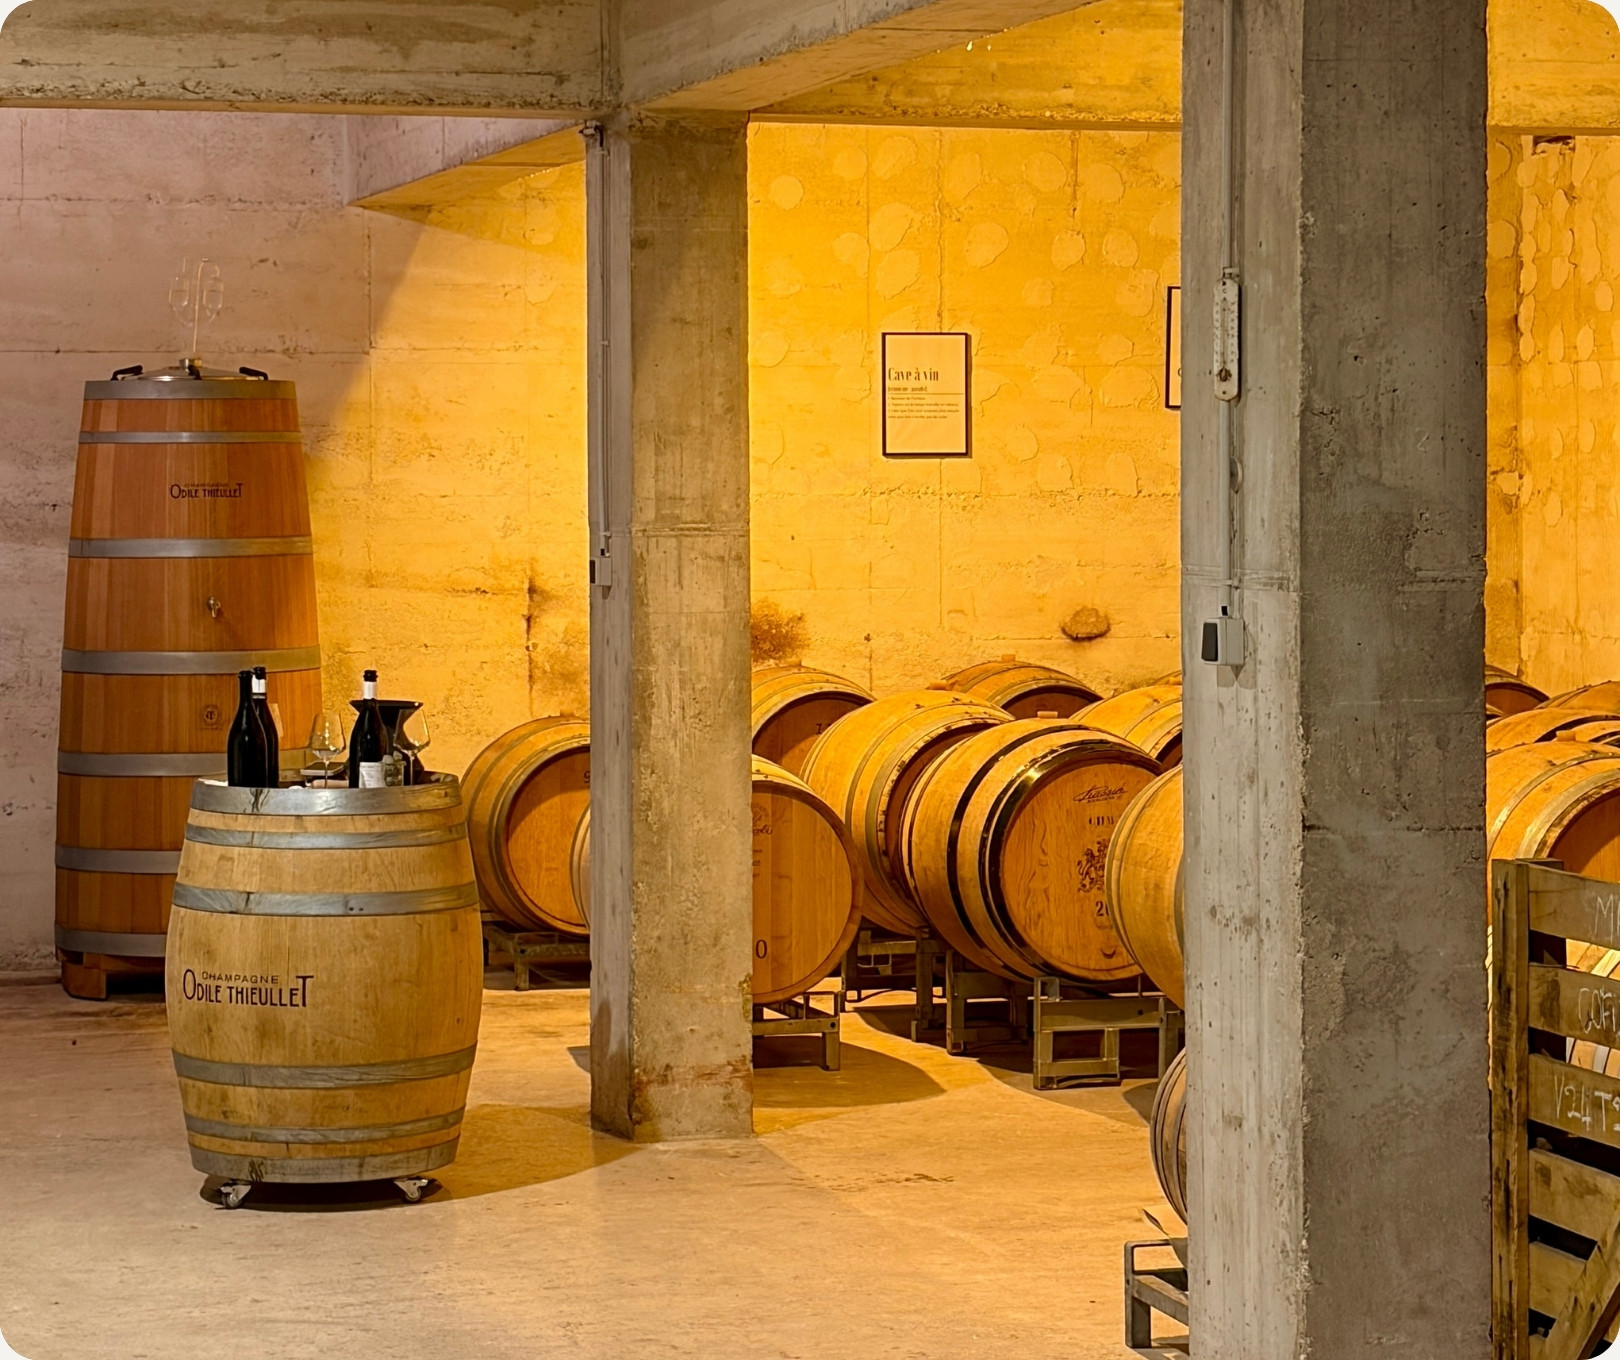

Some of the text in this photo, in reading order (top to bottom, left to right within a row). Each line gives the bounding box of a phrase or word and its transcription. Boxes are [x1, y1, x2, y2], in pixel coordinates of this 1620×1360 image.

[888, 367, 939, 381] Cave à vin
[201, 971, 280, 985] CHAMPAGNE
[183, 968, 314, 1008] ODILE THIEULLET
